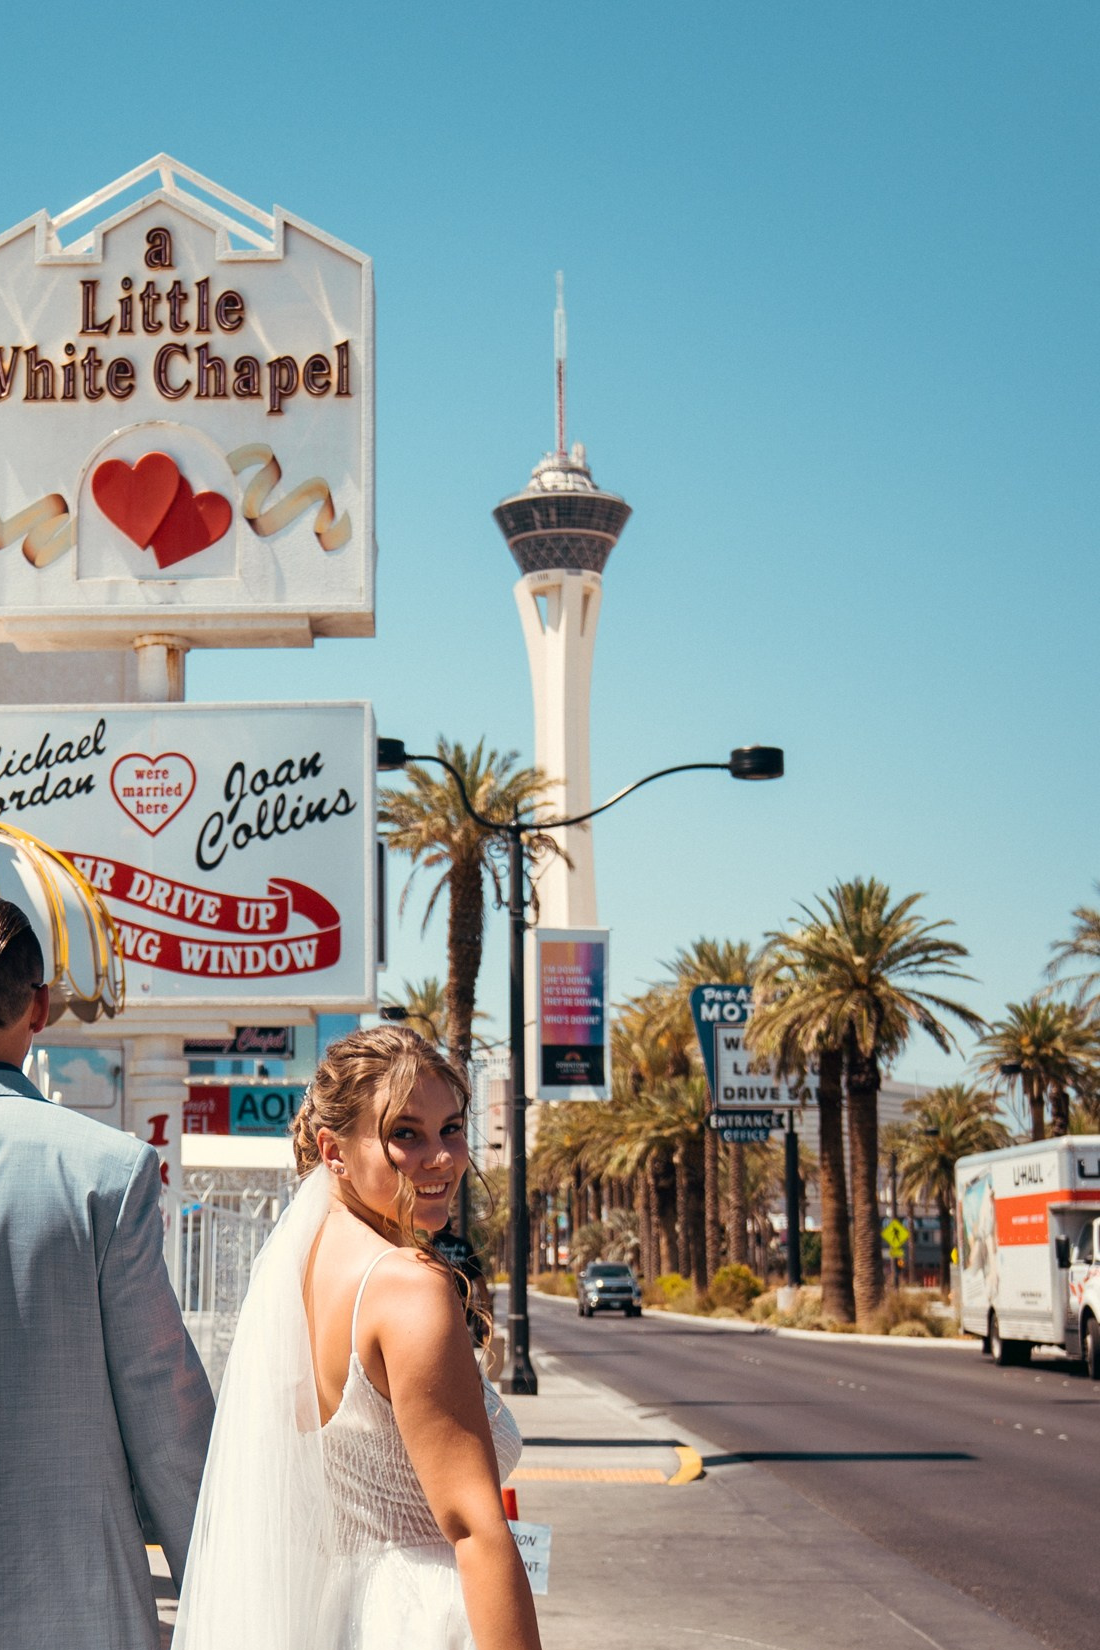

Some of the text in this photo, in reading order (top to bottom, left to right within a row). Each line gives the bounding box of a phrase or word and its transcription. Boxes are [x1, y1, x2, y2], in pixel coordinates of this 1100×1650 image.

[144, 227, 174, 269] a
[79, 277, 246, 335] Little
[152, 339, 353, 416] Chapel
[122, 783, 183, 798] married
[134, 768, 170, 780] were
[224, 752, 325, 825] Joan
[135, 800, 169, 815] here
[195, 788, 358, 872] Collins
[126, 871, 222, 925] DRIVE
[236, 901, 278, 931] UP
[179, 938, 319, 975] WINDOW
[723, 1087, 780, 1100] DRIVE
[709, 1113, 781, 1129] ENTRANCE
[723, 1128, 768, 1142] OFFICE
